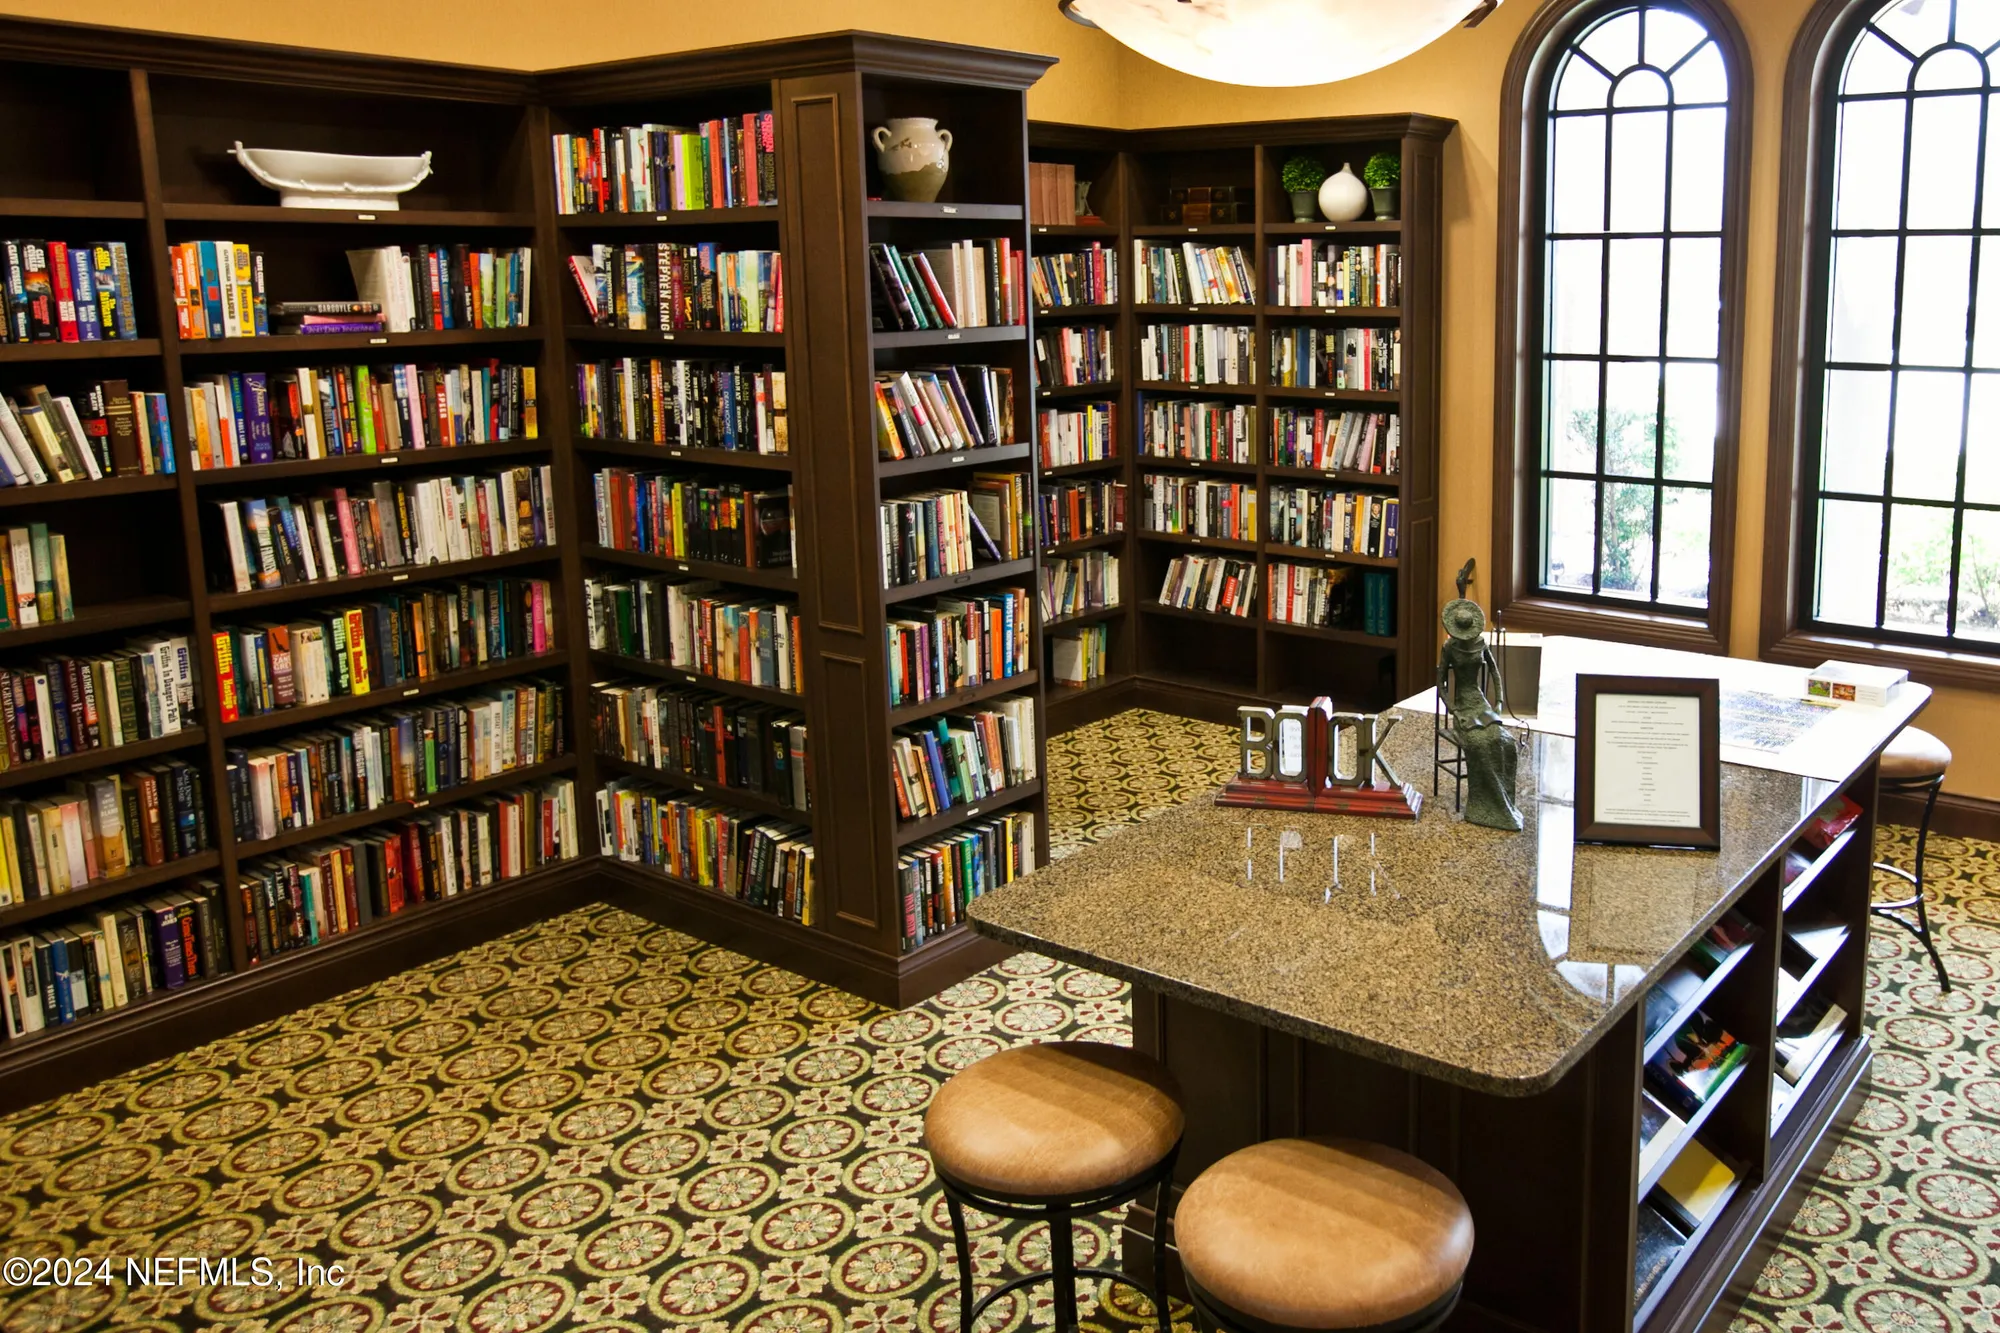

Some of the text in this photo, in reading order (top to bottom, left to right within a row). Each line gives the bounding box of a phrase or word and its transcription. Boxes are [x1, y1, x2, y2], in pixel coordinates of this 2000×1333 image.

[8, 245, 23, 295] CLIVE CUSSLER
[27, 245, 38, 272] CUSSLER
[36, 249, 45, 269] CLIVE
[225, 283, 236, 319] TREASURE
[658, 243, 671, 331] STEPHEN KING
[59, 301, 69, 322] DEATH
[90, 392, 99, 411] DEATH
[94, 385, 105, 417] WRONGFUL
[177, 647, 188, 680] Griffin
[216, 635, 232, 674] Griffin
[81, 666, 97, 721] HEATHER GRAHAM
[1237, 705, 1402, 788] BOOK
